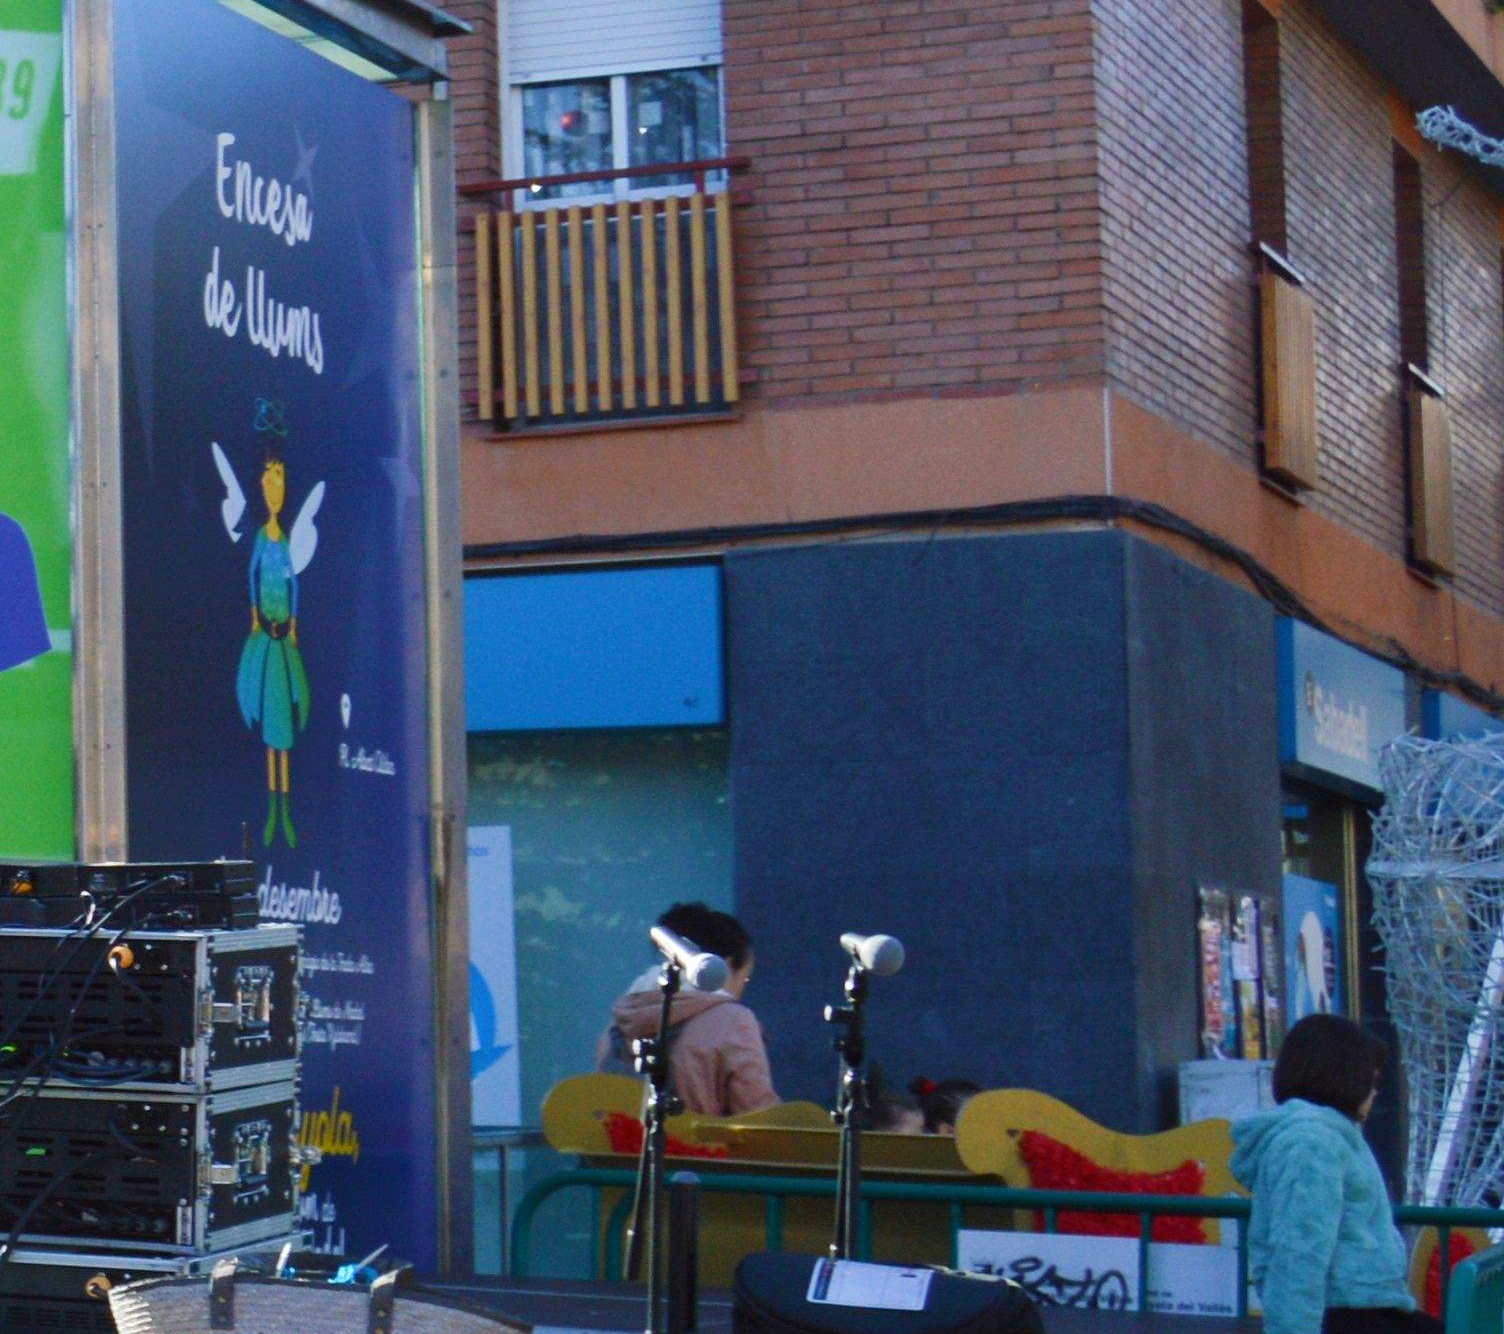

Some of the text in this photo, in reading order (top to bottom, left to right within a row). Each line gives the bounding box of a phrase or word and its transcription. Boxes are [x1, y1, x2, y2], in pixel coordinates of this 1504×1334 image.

[217, 132, 313, 246] Encesa
[204, 246, 323, 374] de llums
